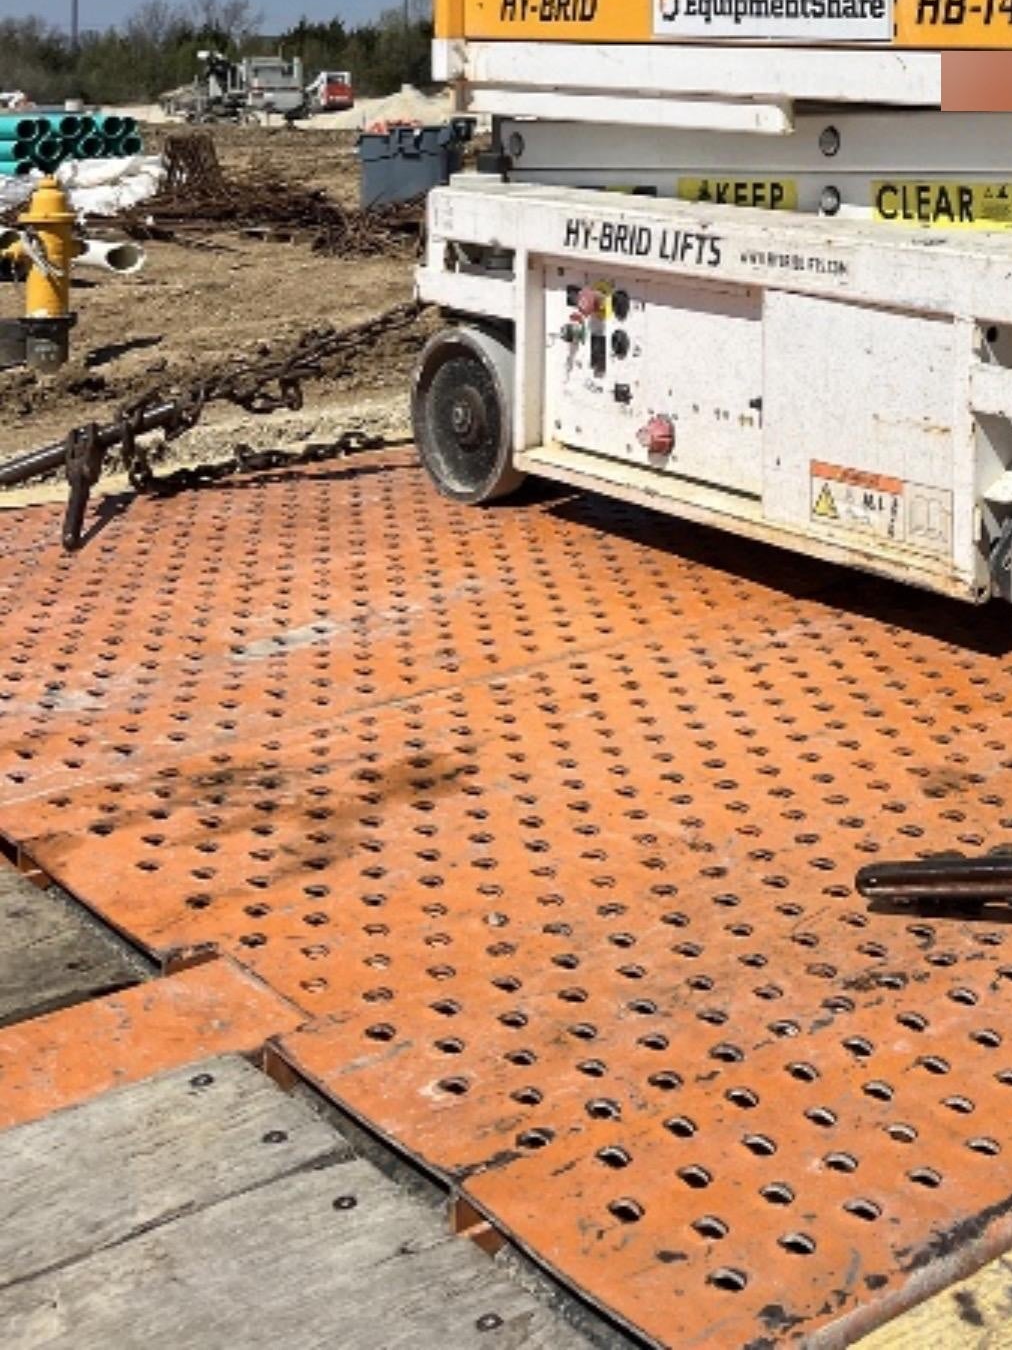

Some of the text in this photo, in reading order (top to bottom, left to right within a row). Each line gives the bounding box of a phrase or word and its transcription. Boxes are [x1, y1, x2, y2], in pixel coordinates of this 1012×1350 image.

[715, 182, 784, 210] KEEP
[876, 184, 974, 223] CLEAR
[564, 218, 651, 256] HY-BRID
[659, 229, 722, 267] LIFTS
